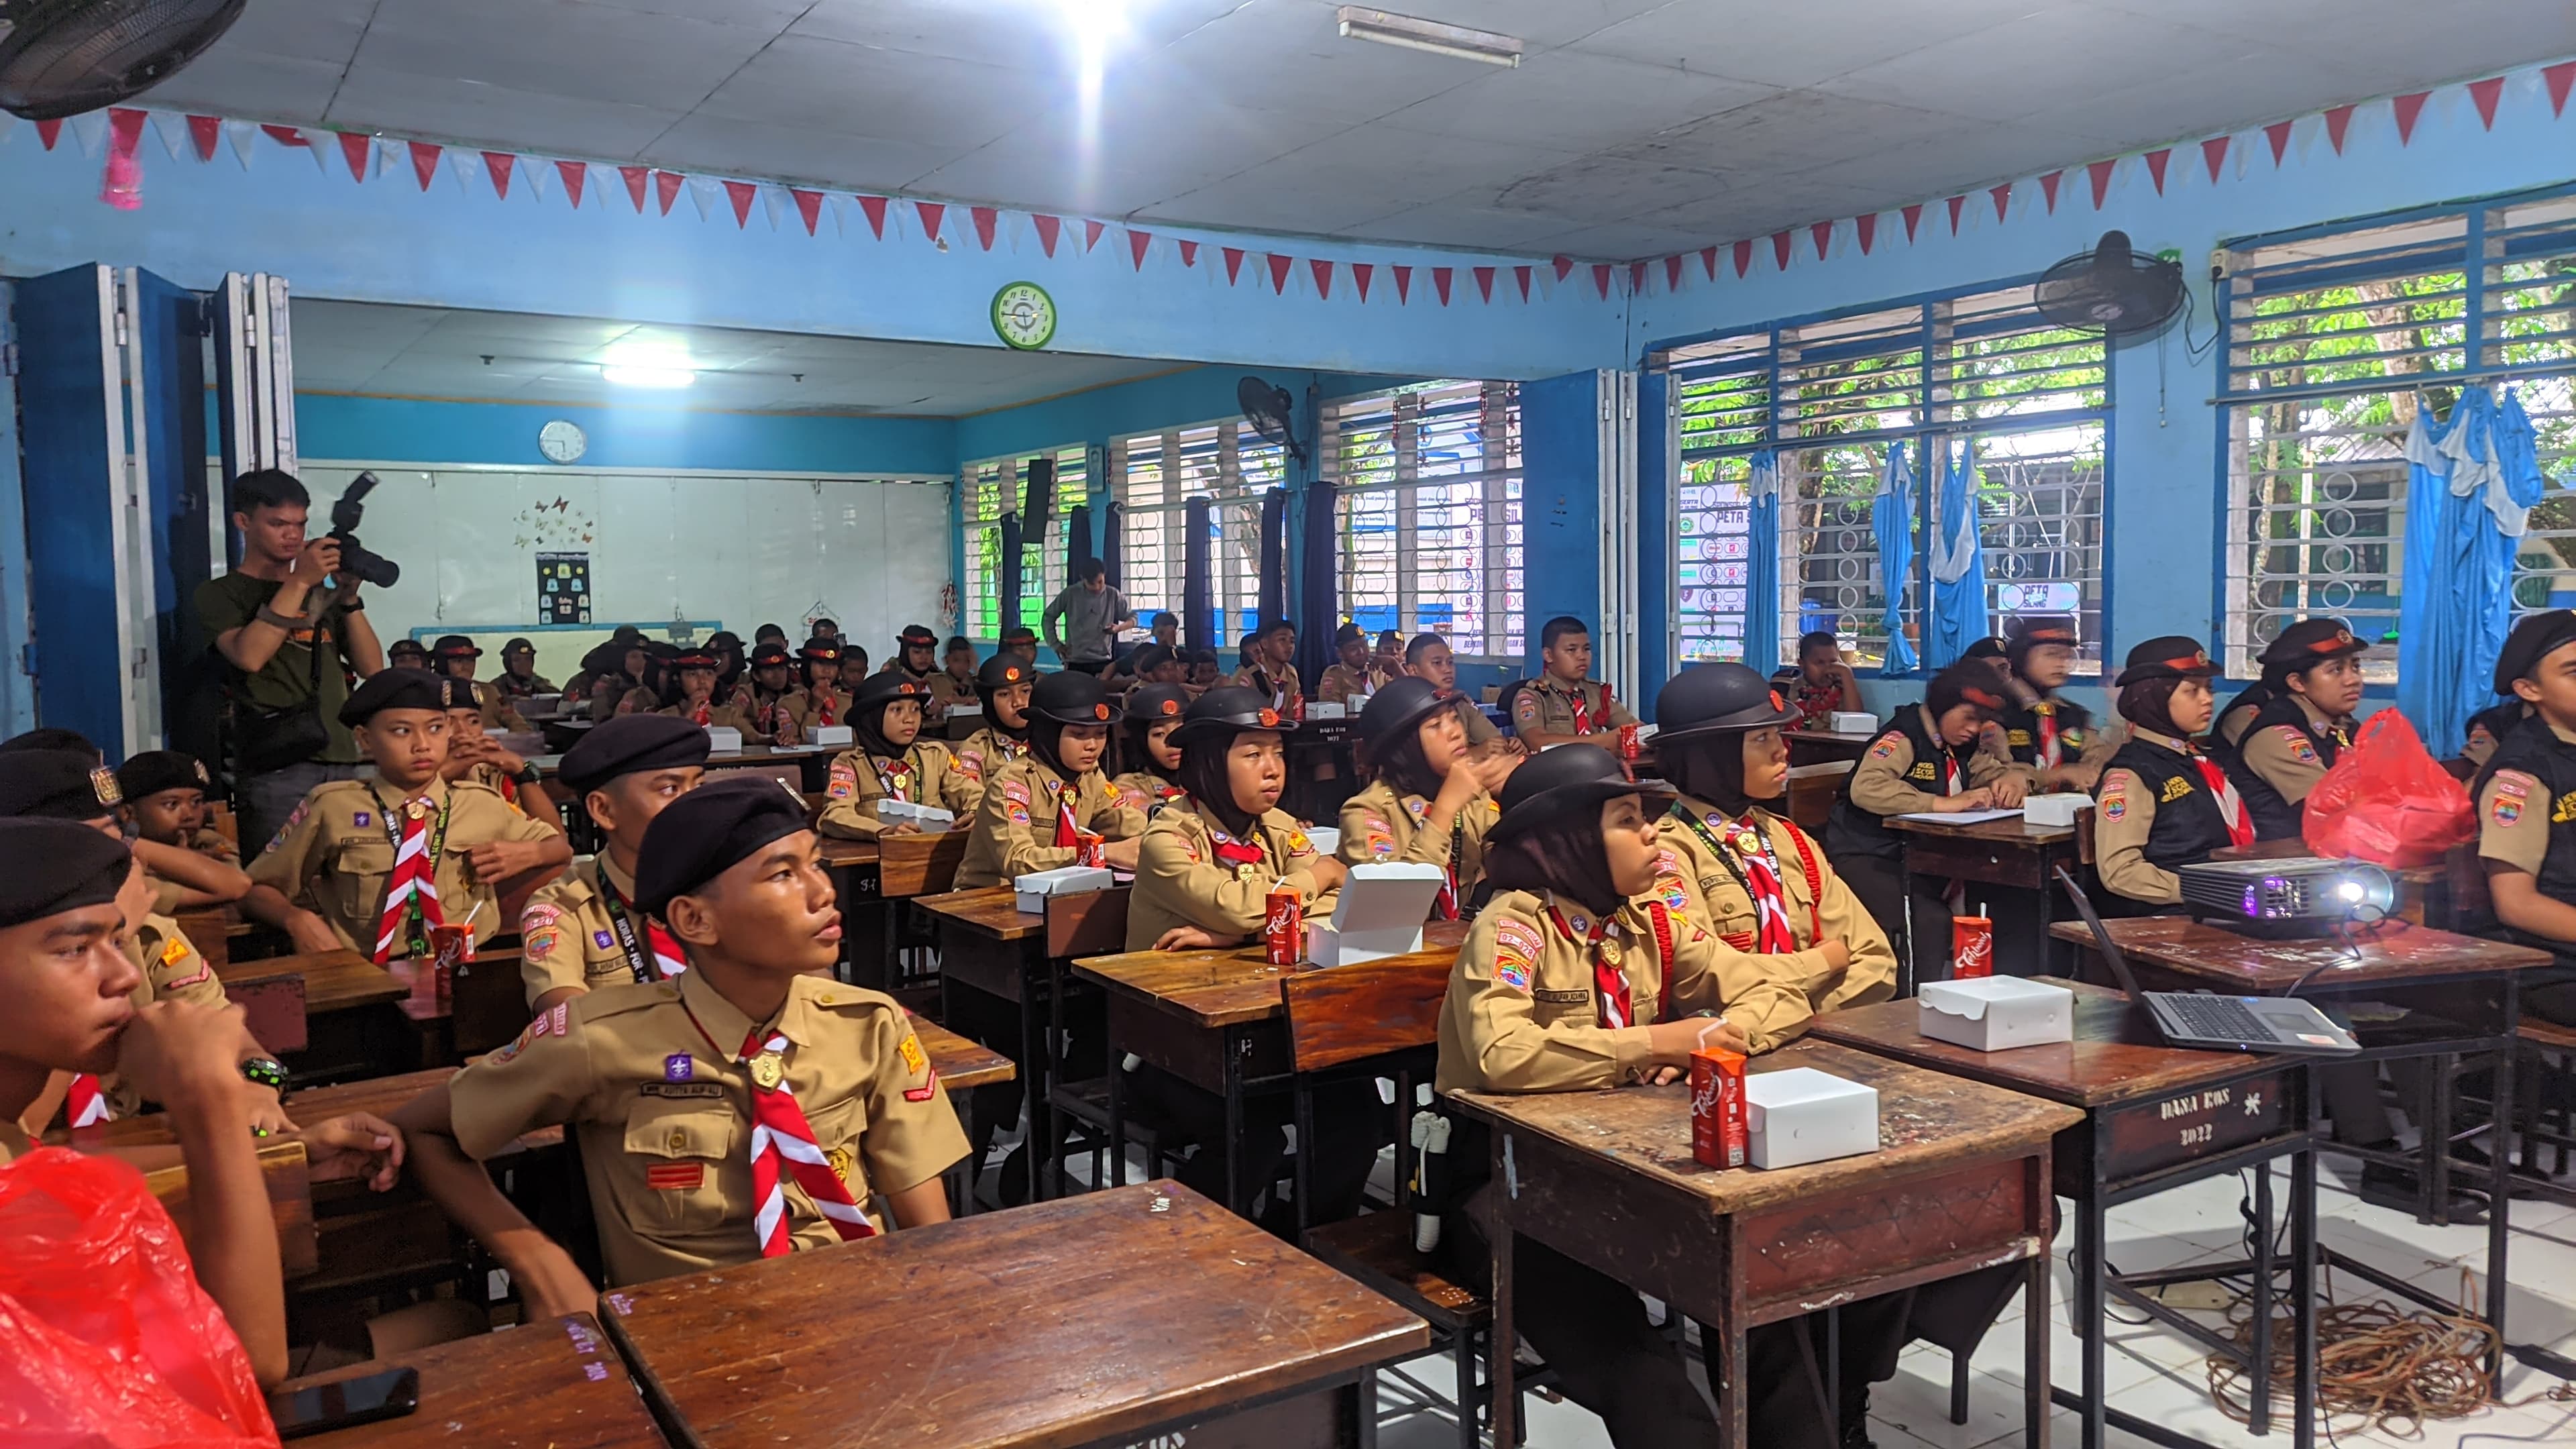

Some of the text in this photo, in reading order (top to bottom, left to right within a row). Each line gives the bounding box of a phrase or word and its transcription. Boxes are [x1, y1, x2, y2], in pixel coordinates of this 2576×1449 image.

[1717, 511, 1743, 523] PETA
[616, 918, 635, 947] HORAS
[629, 952, 644, 971] FOR
[1502, 934, 1534, 957] 02-028
[2180, 1123, 2212, 1146] 2022
